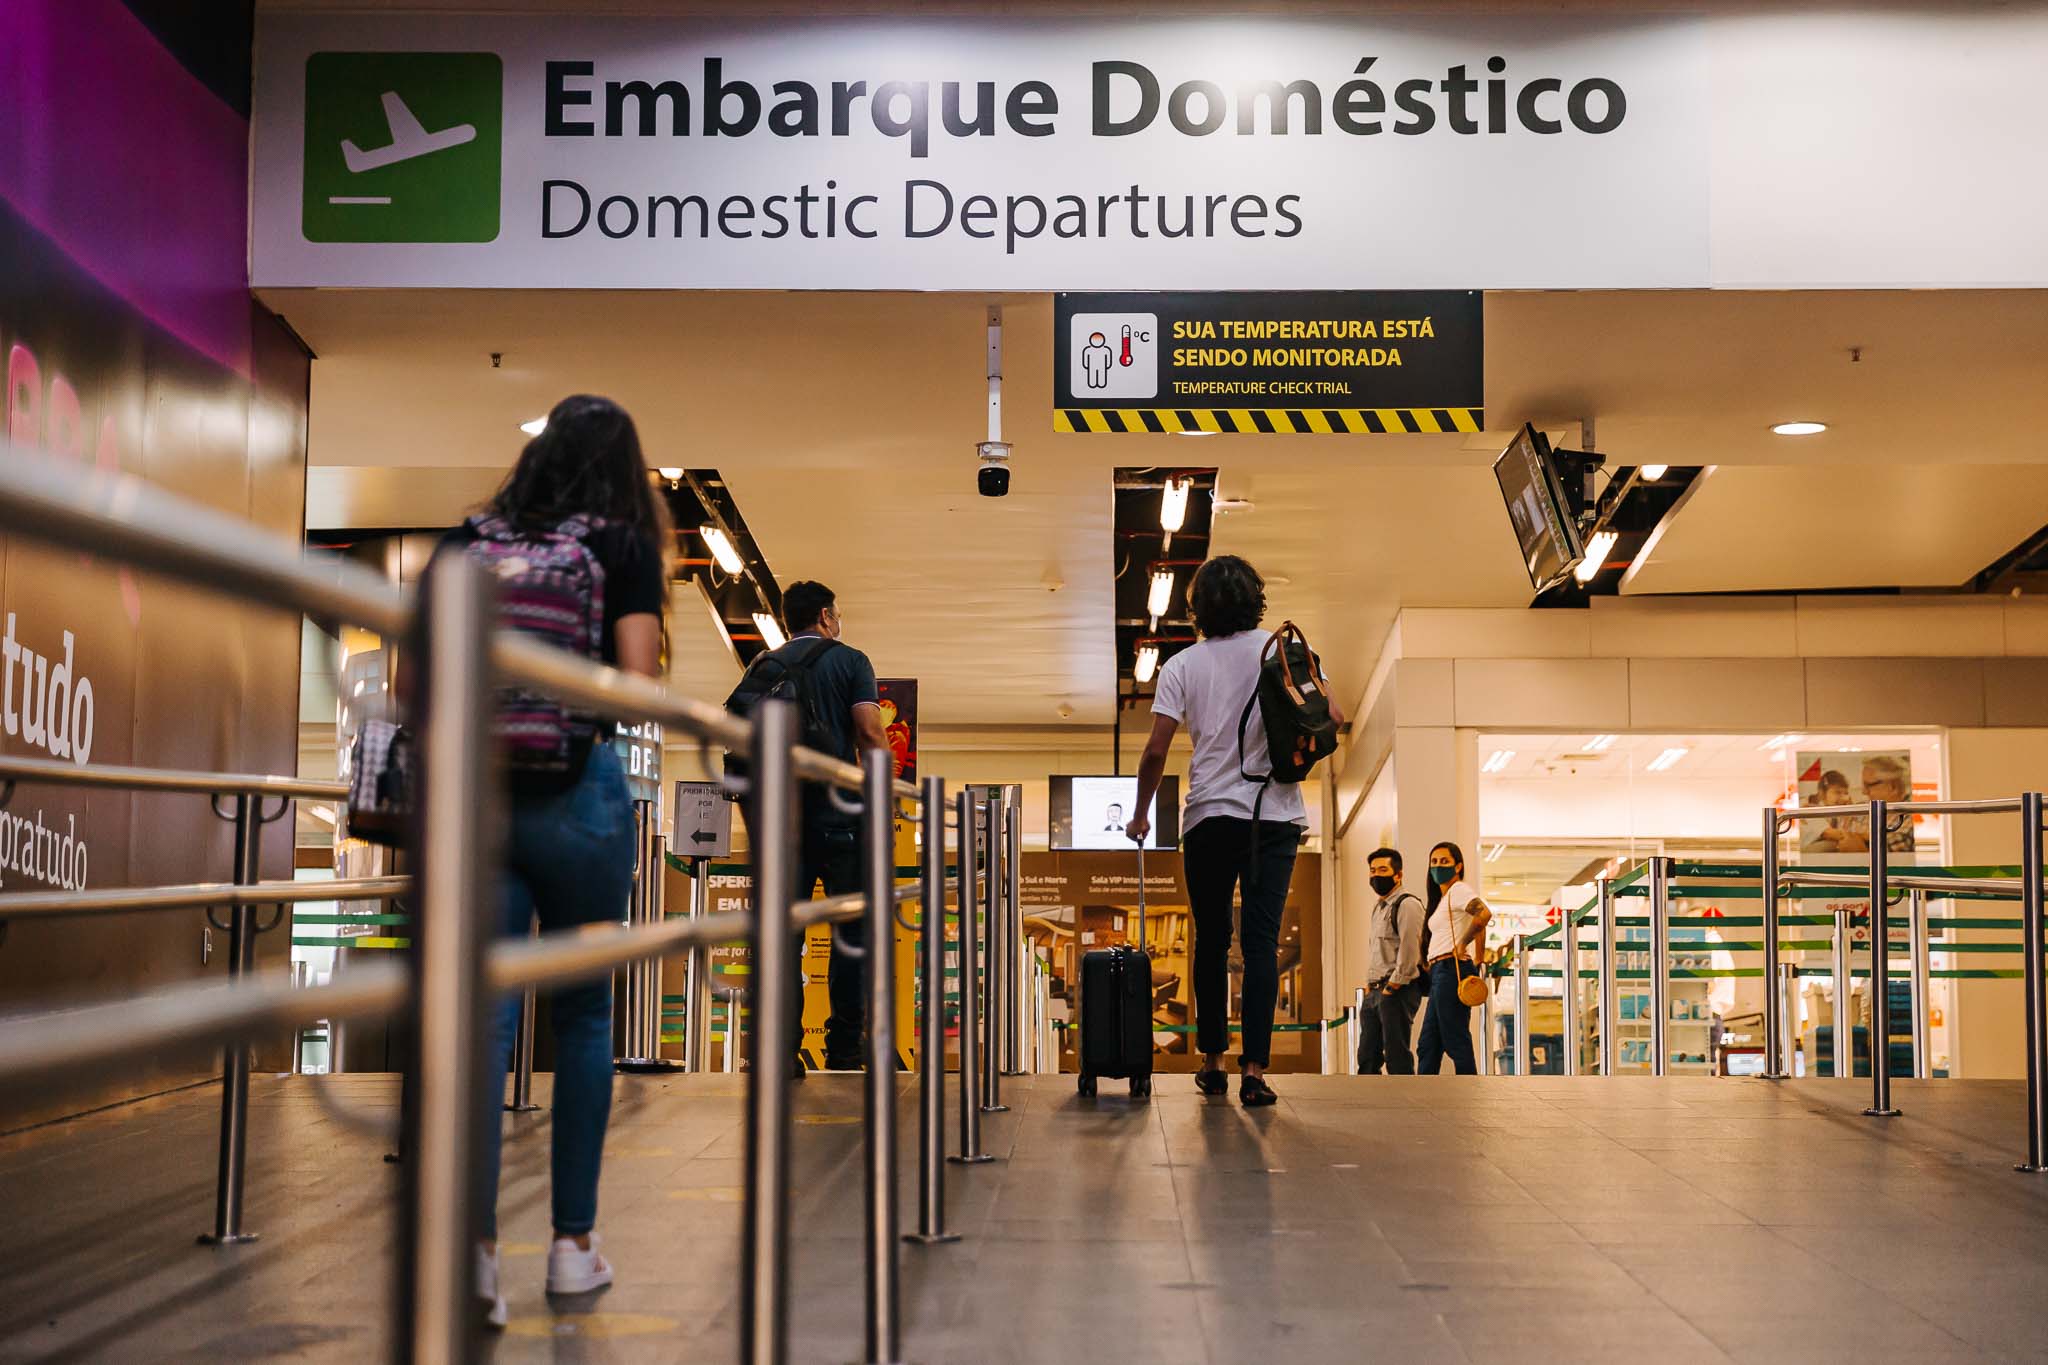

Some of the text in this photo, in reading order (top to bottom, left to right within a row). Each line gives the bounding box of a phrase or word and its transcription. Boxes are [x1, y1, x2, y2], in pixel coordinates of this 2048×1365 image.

[544, 55, 1627, 158] Embarque Doméstico
[541, 179, 1303, 255] Domestic Departures
[1173, 316, 1435, 339] SUA TEMPERATURA ESTÁ
[1173, 348, 1402, 367] SENDO MONITORADA
[1172, 381, 1352, 394] TEMPERATURE CHECK TRIAL
[0, 612, 94, 767] tudo
[683, 786, 723, 796] PRIORIDAD
[708, 875, 753, 889] SPERE
[1091, 876, 1108, 884] Sala
[1109, 876, 1122, 884] VIP
[717, 898, 742, 911] EM
